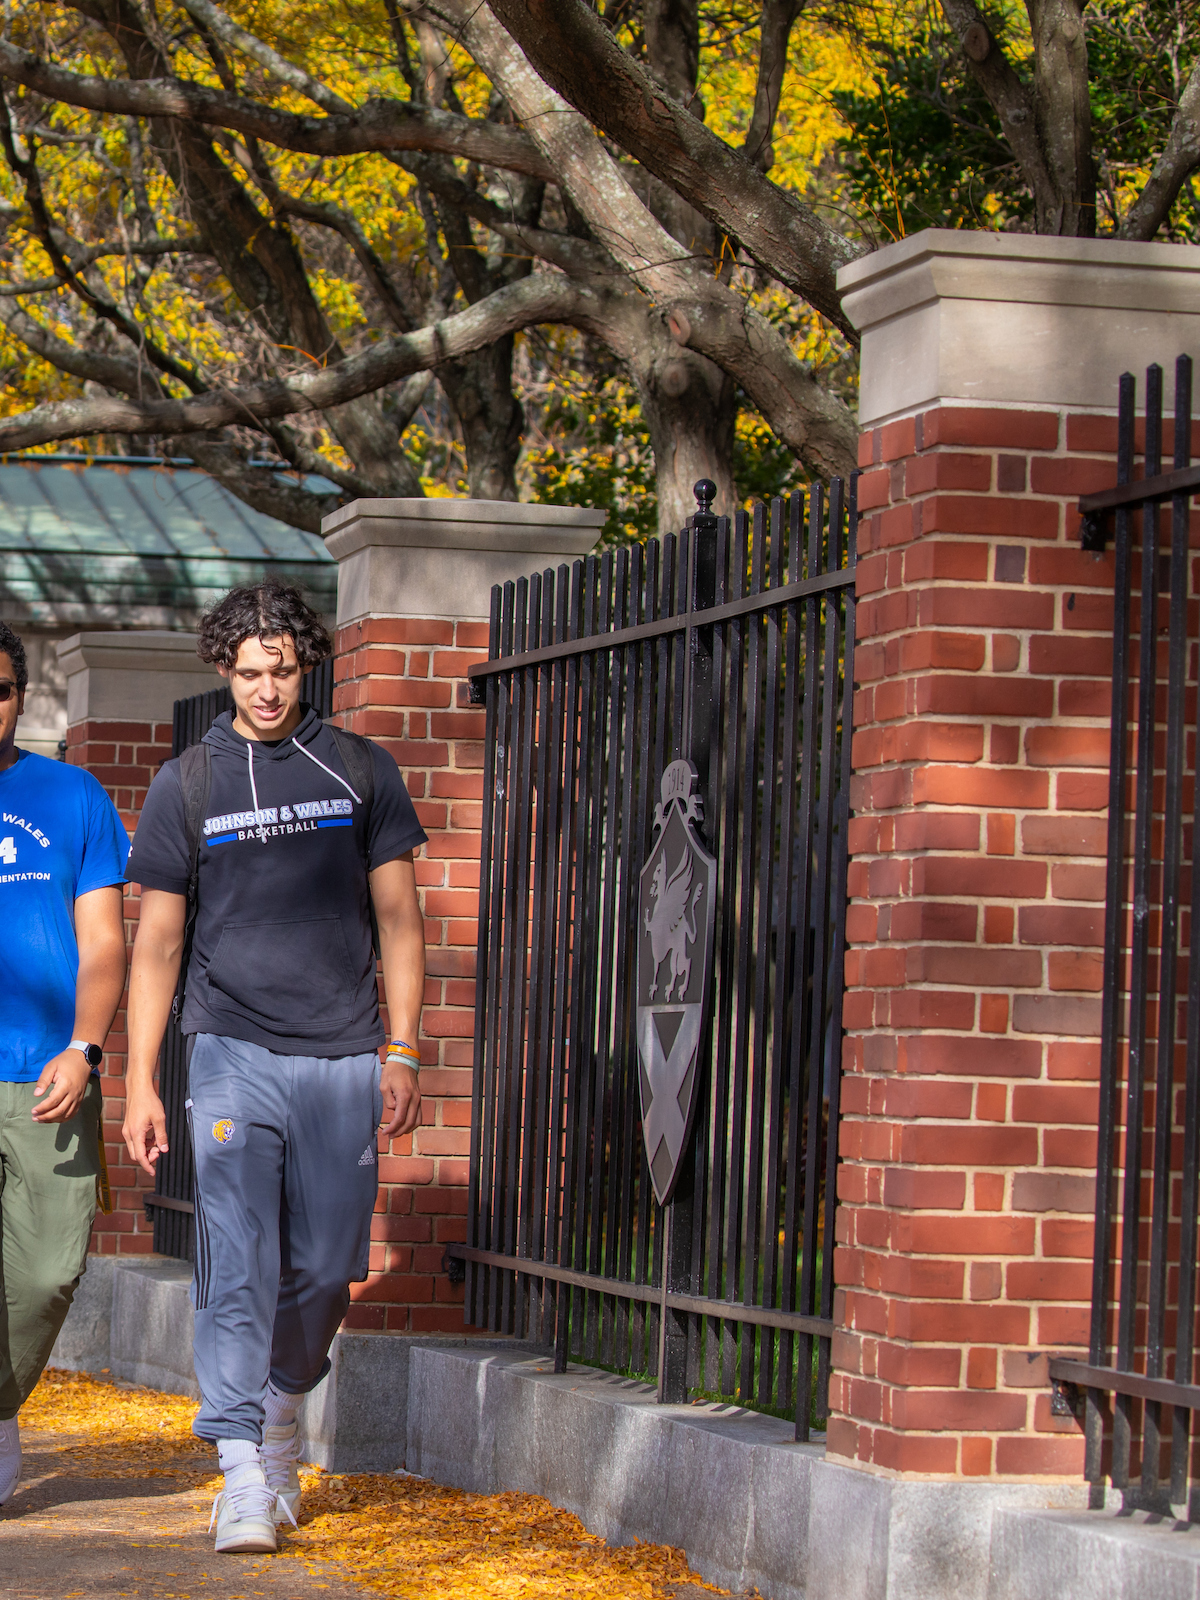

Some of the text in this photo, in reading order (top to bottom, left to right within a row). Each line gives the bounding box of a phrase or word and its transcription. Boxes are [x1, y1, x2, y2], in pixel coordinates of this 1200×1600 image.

[2, 812, 51, 848] WALES
[203, 799, 354, 835] JOHNSON & WALES
[237, 820, 318, 841] BASKETBALL
